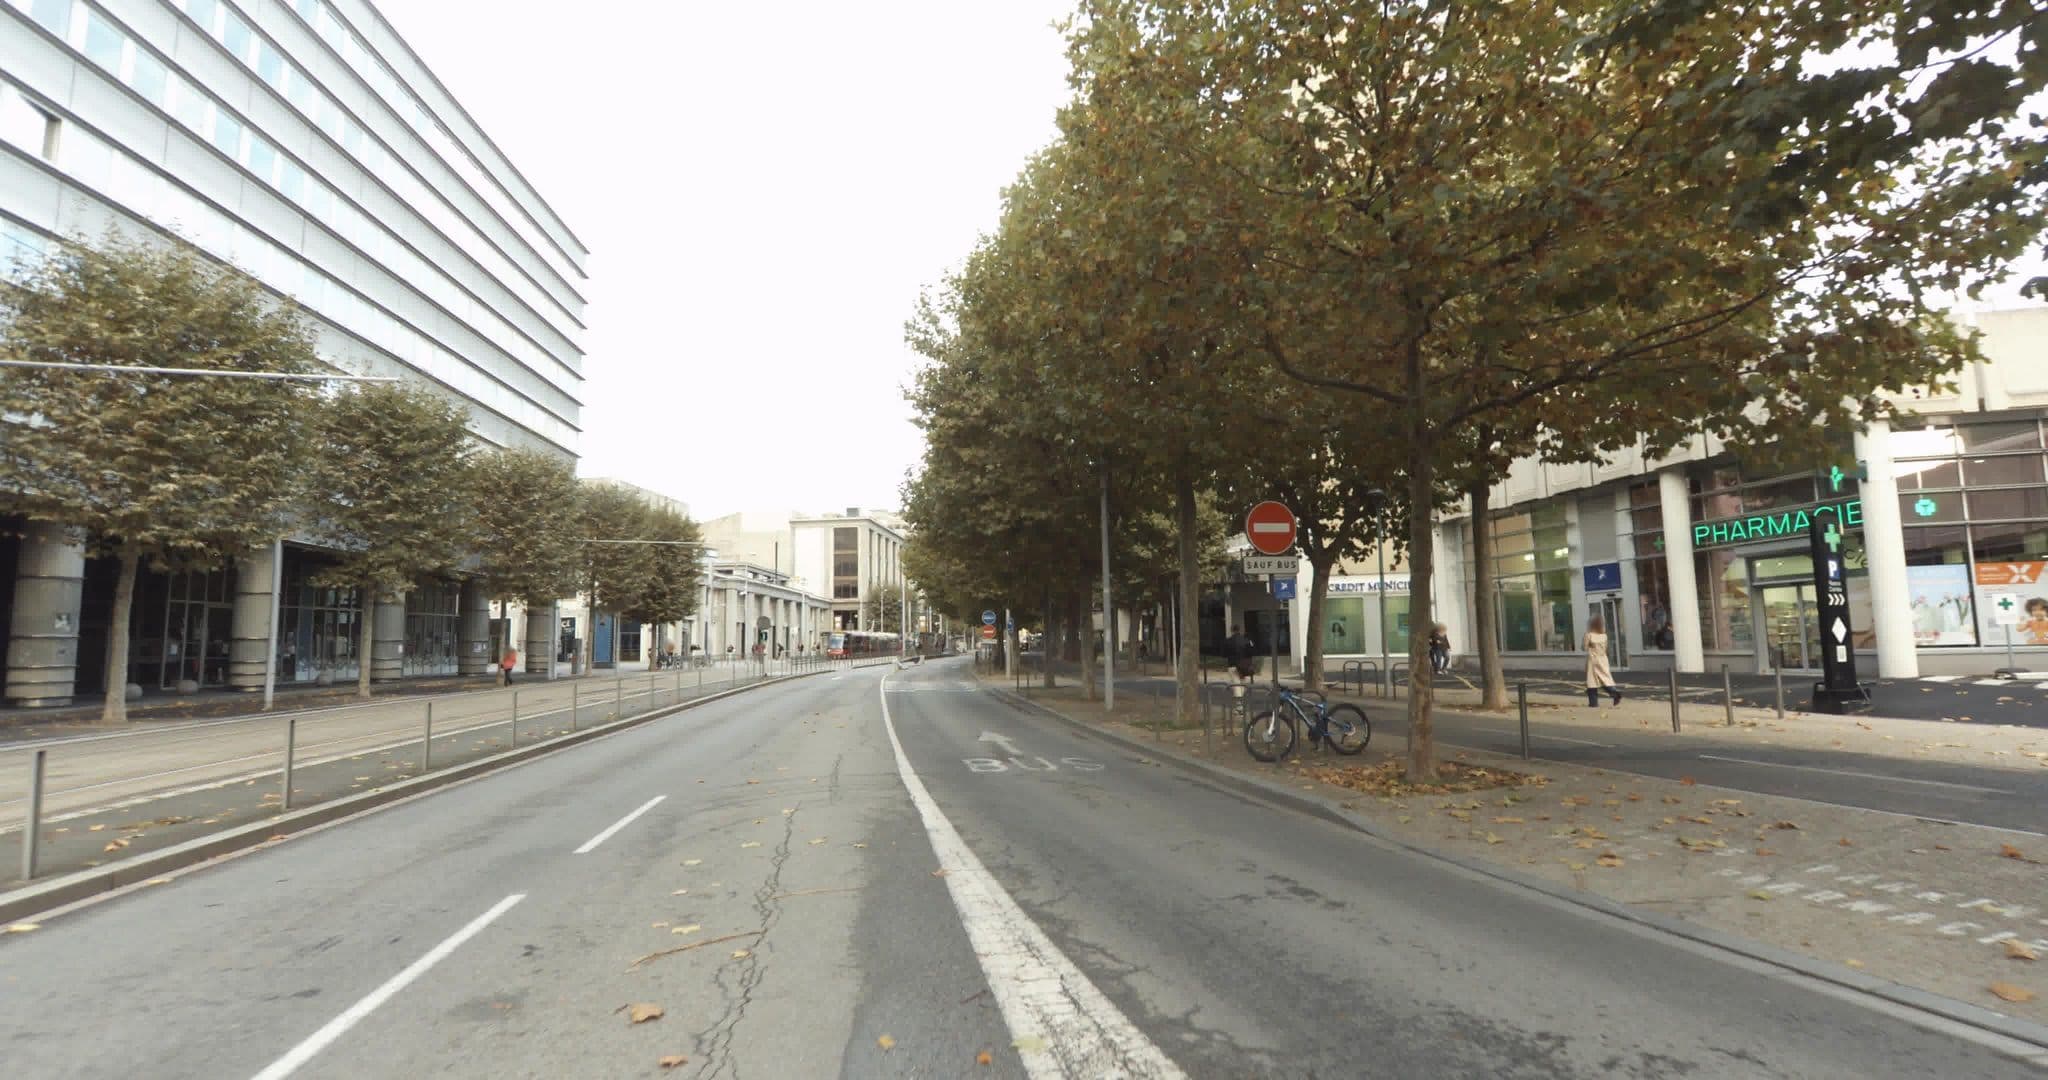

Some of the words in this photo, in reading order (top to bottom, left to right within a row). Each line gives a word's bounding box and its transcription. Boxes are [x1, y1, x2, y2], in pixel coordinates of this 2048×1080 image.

[1694, 501, 1865, 546] PHARMAIE
[1246, 561, 1273, 570] SAUF
[1277, 560, 1297, 570] BUS
[960, 756, 1105, 772] BUS
